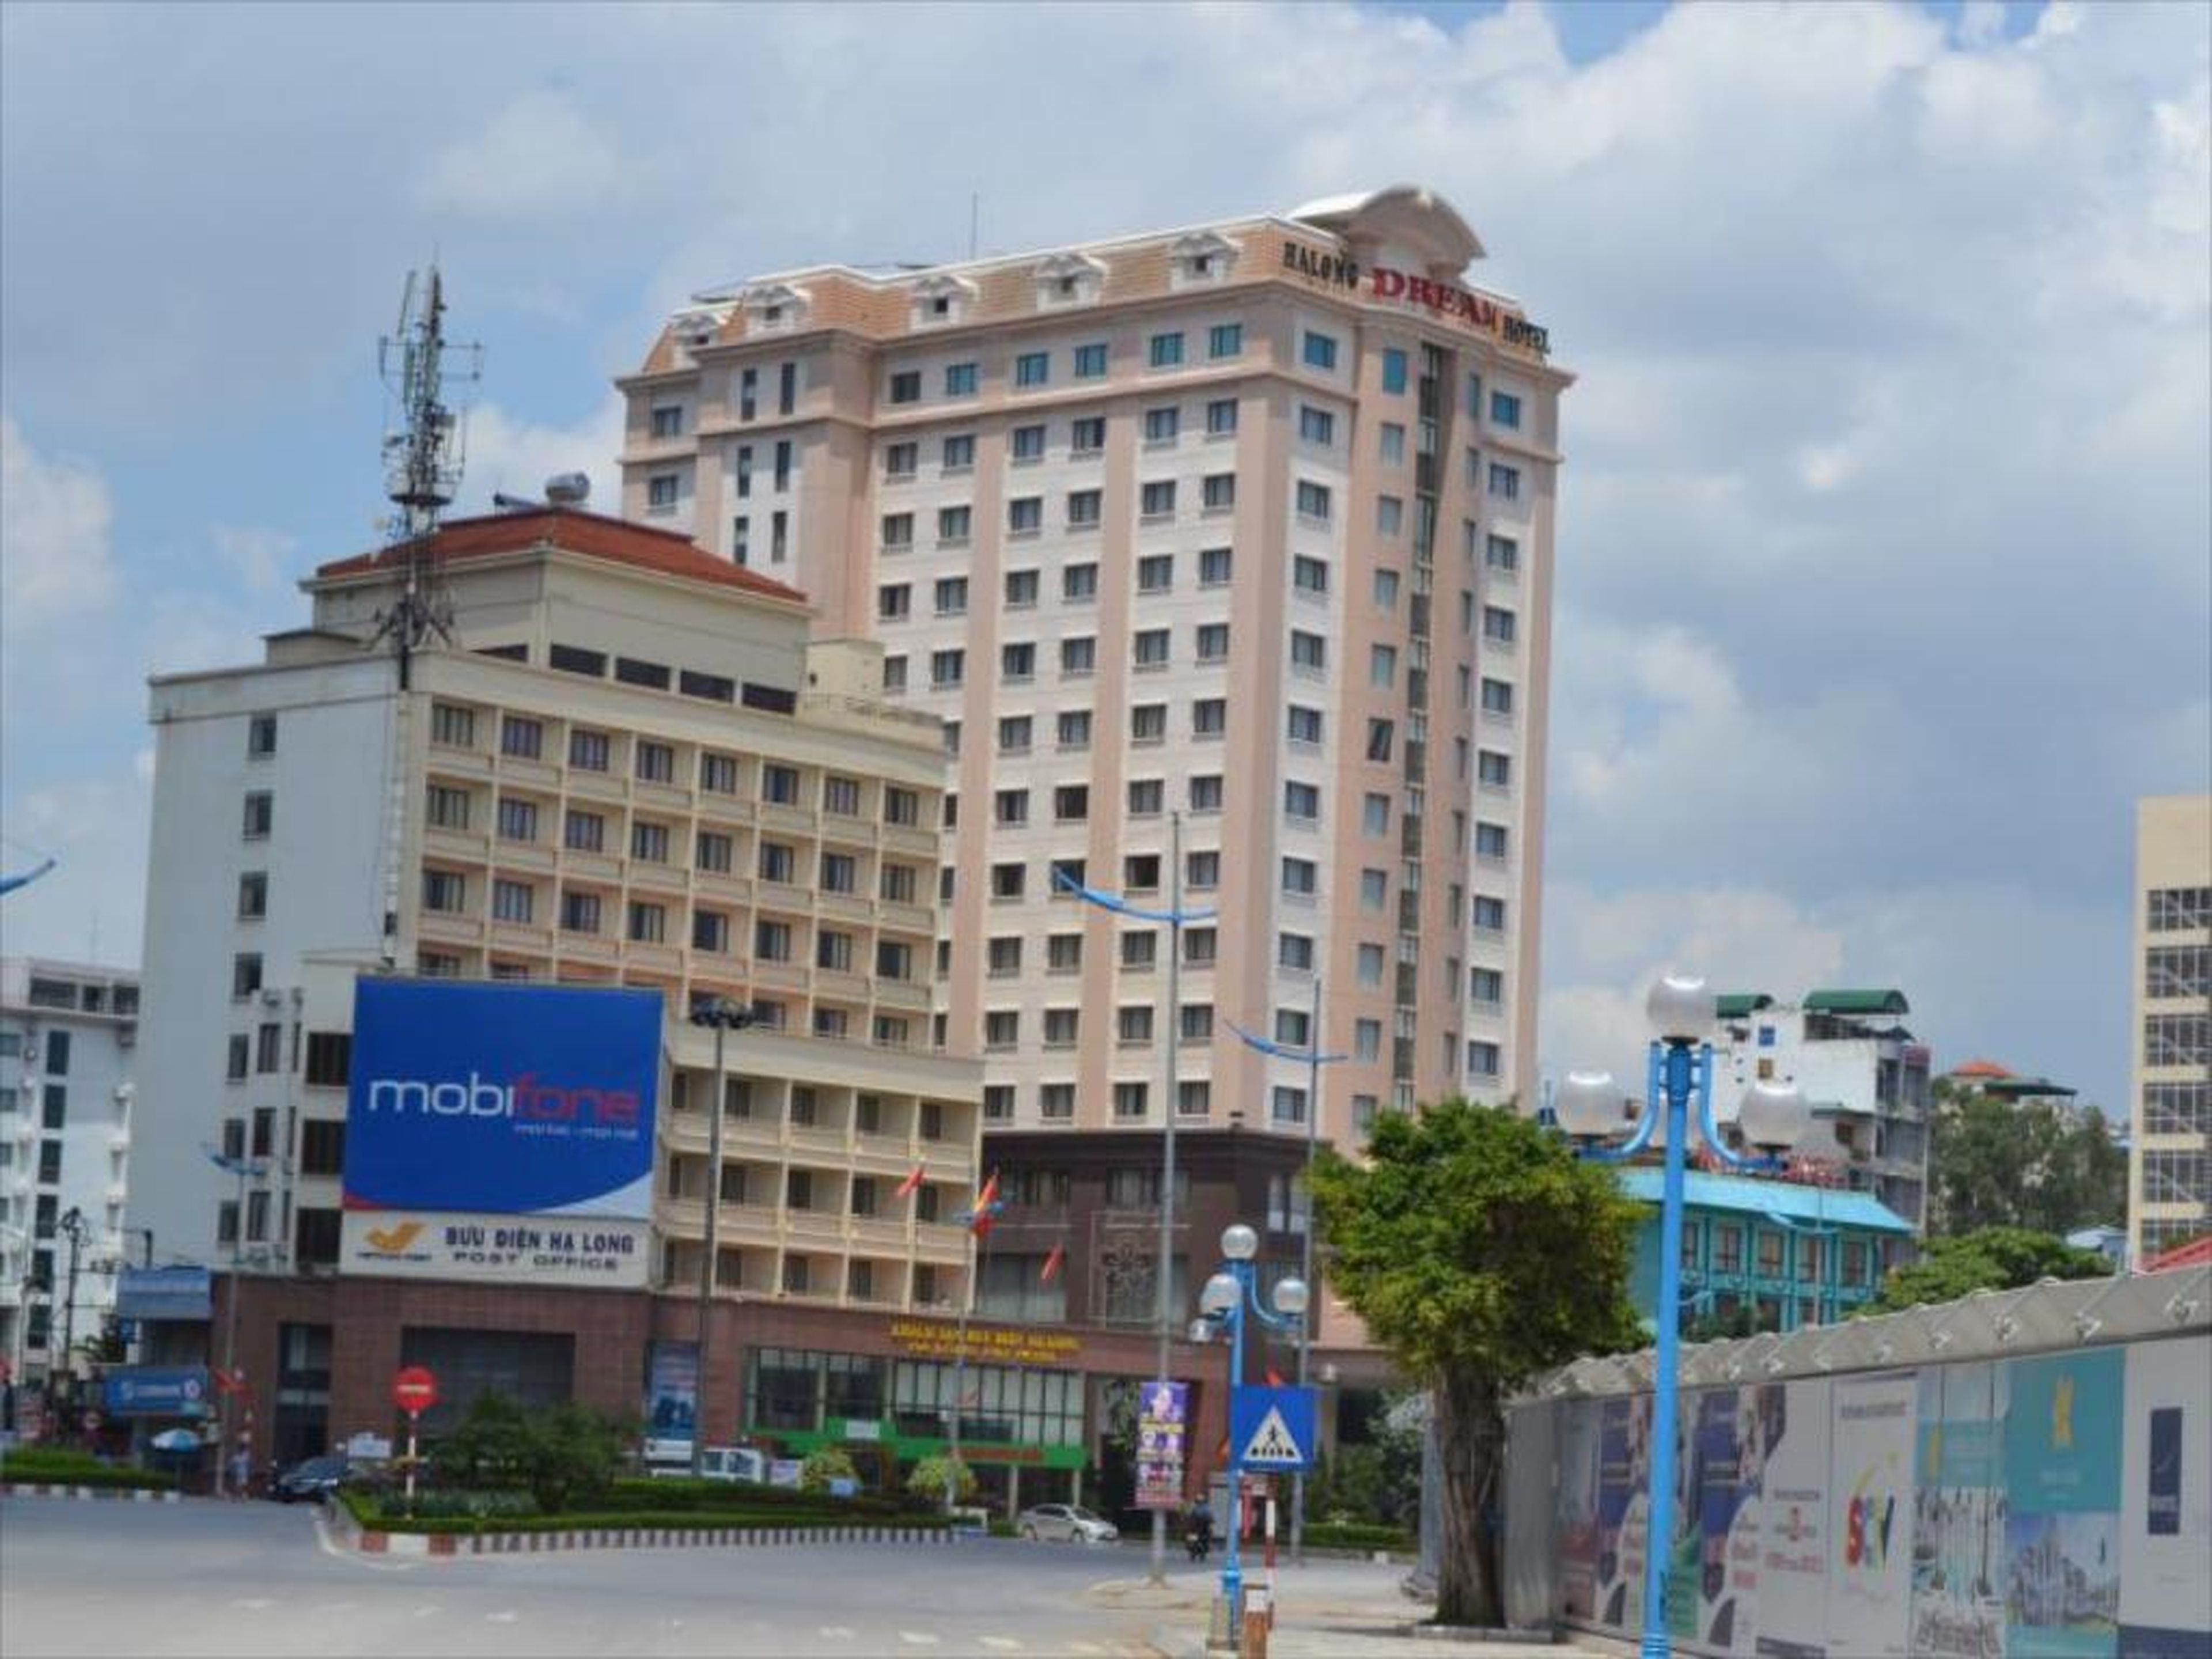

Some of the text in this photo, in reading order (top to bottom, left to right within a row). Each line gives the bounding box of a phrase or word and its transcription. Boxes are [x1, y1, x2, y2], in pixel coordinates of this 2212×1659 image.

[1373, 267, 1498, 332] DREAM
[368, 1071, 639, 1123] mobifone
[453, 1251, 619, 1271] POST OFFICE
[583, 1233, 634, 1255] LONG
